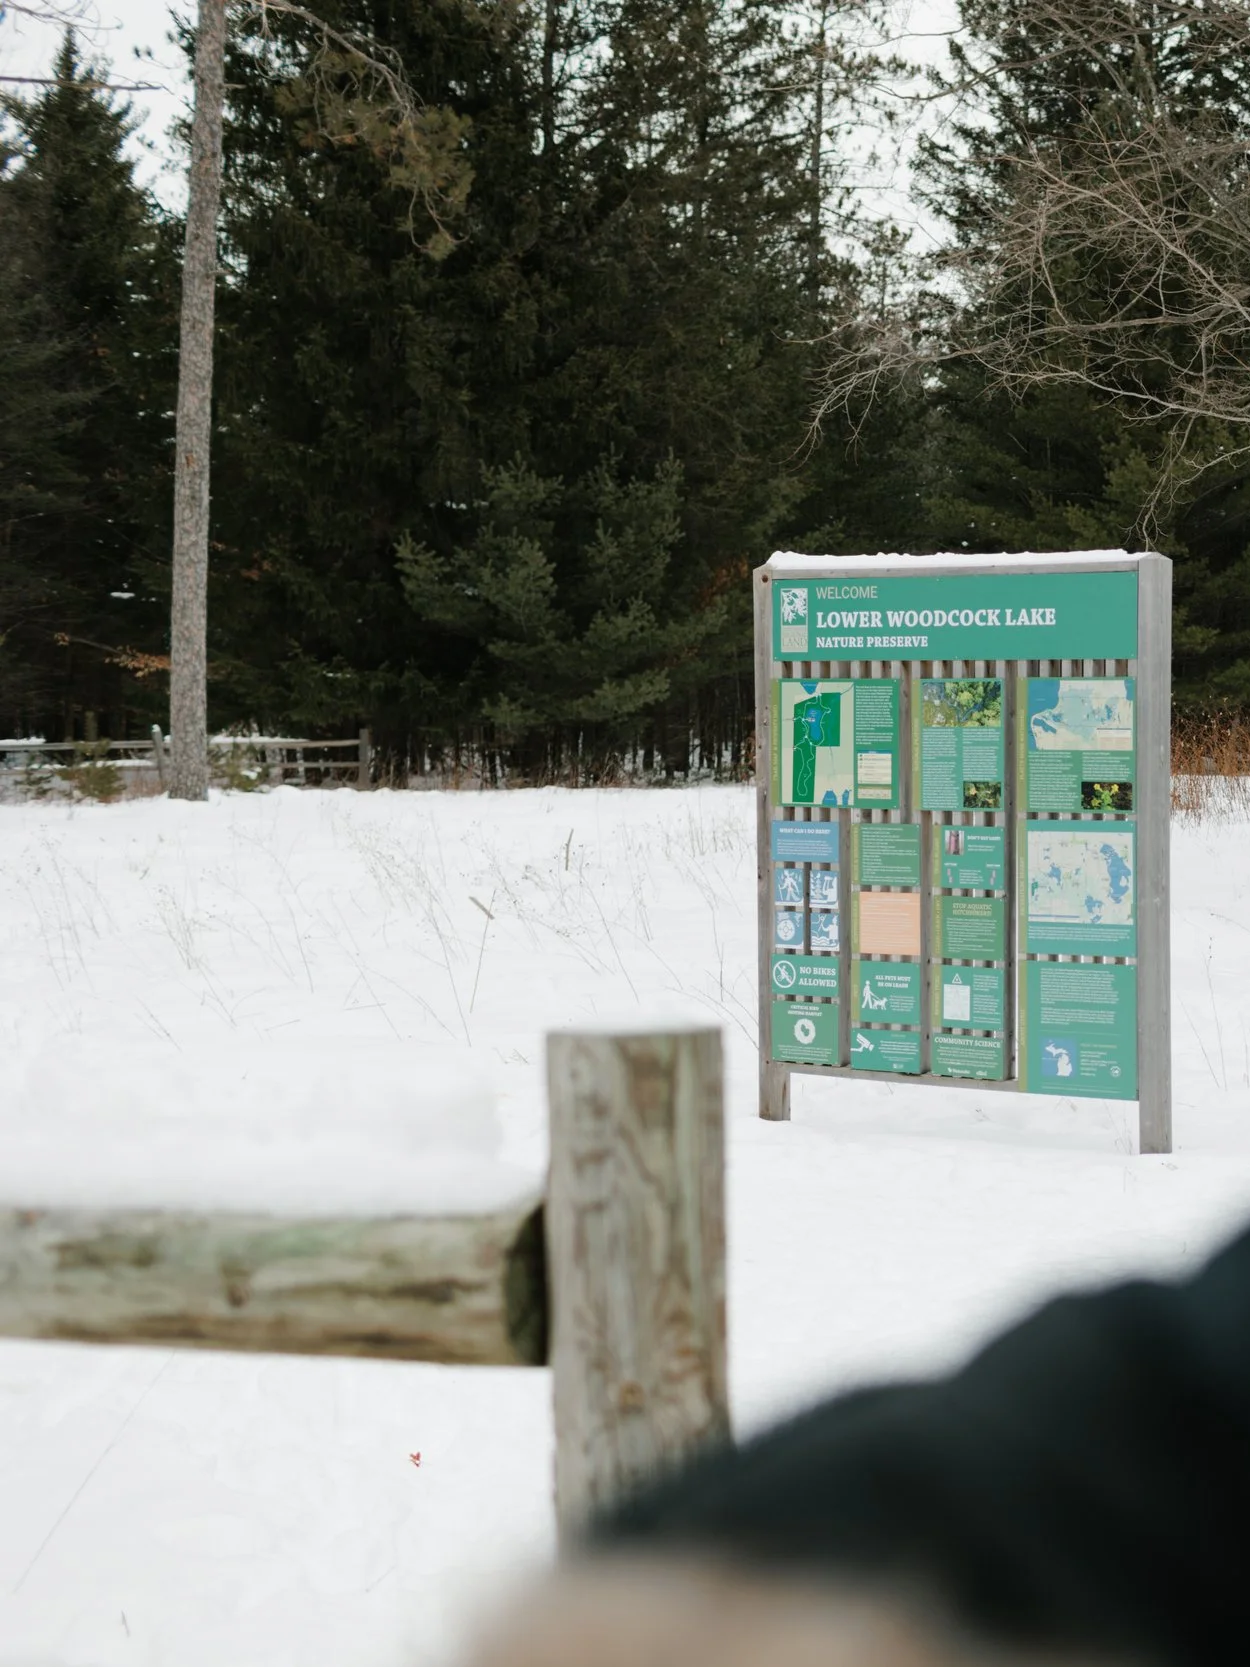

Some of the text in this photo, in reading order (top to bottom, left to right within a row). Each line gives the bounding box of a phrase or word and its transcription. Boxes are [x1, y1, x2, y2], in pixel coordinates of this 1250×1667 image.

[816, 586, 878, 599] WELCOME
[816, 608, 1056, 628] LOWER WOODCOCK LAKE
[816, 636, 929, 648] NATURE PRESERVE
[799, 966, 836, 976] NO BIKES
[798, 978, 837, 988] ALLOWED
[934, 1037, 1001, 1049] COMMUNITY SCIENCE
